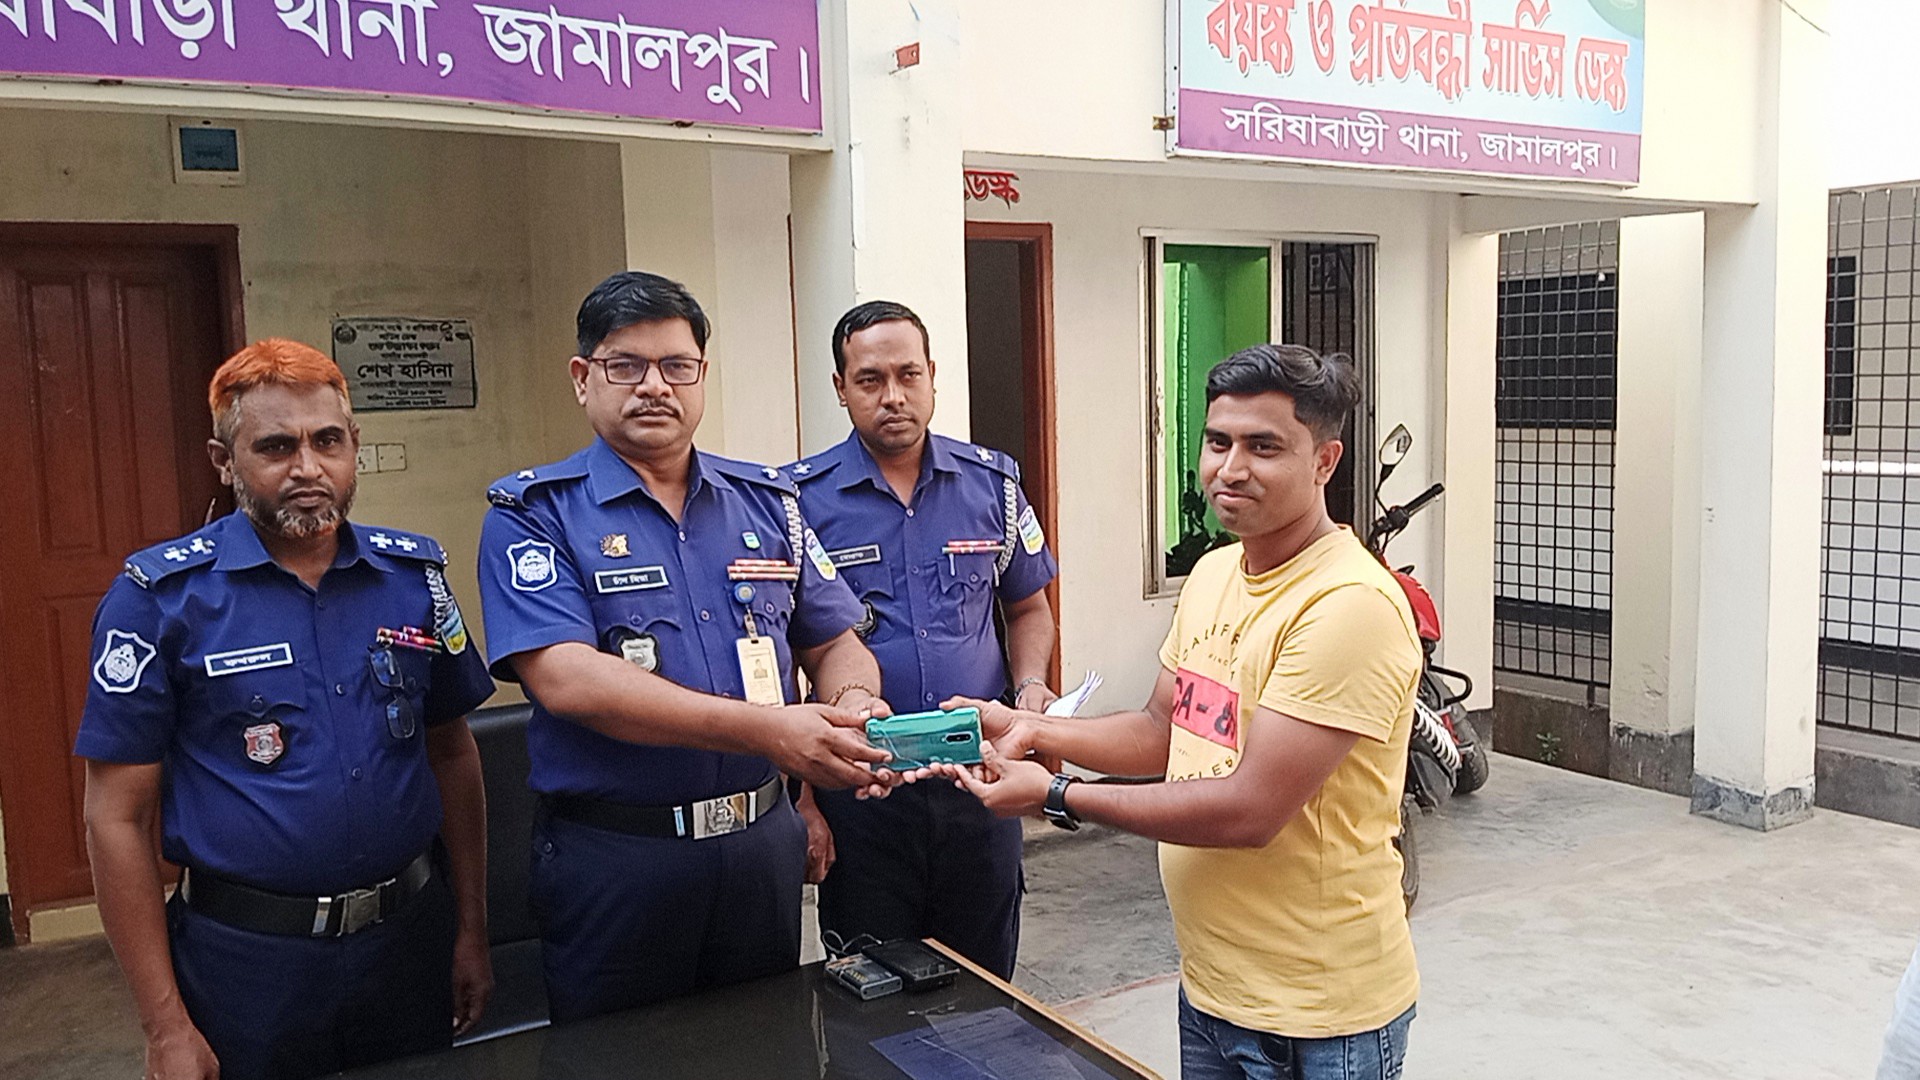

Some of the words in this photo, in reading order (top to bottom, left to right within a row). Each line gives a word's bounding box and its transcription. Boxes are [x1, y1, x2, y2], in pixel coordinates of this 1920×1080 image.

[1221, 101, 1390, 155] সরিষাবাড়ী
[1398, 123, 1468, 162] থানা,
[964, 169, 1020, 210] ডস্ক
[357, 363, 393, 379] শেখ
[398, 360, 454, 379] হাসিনা
